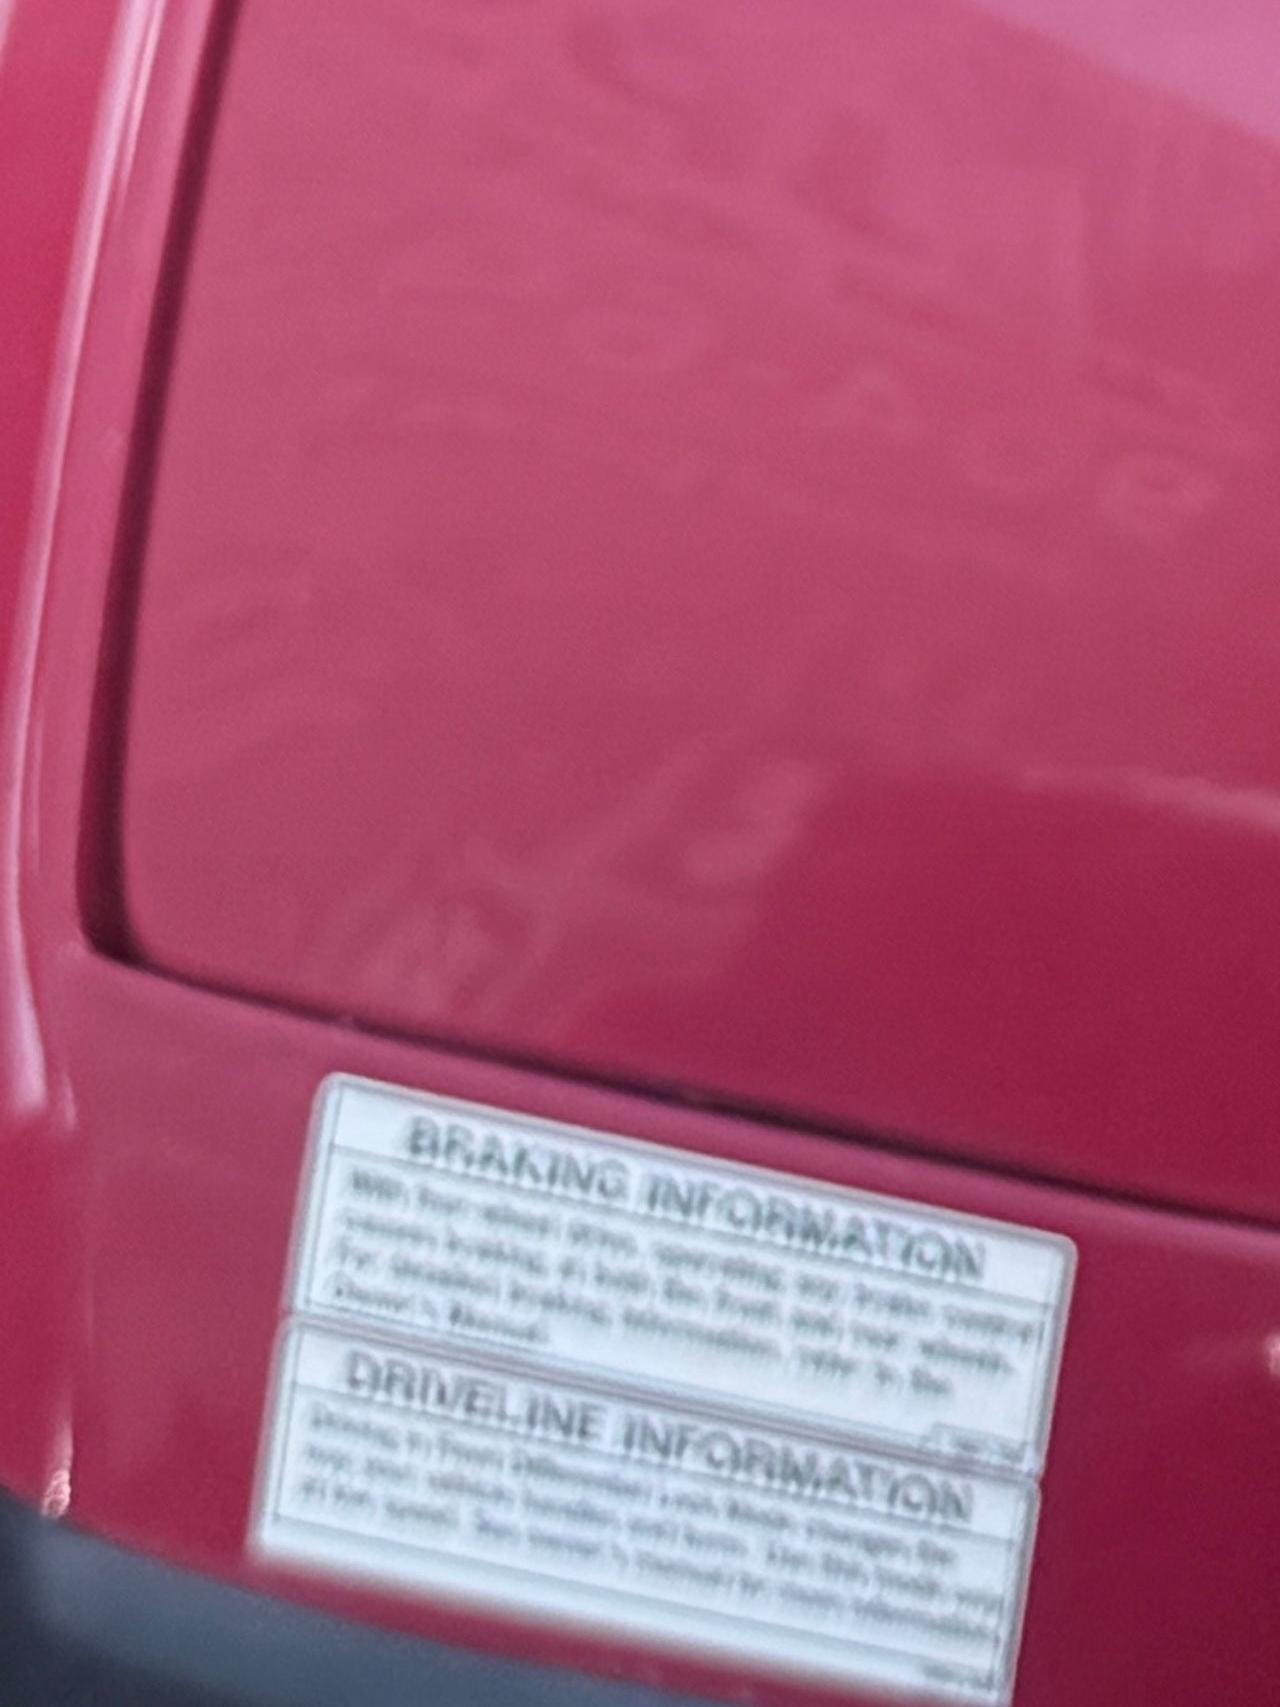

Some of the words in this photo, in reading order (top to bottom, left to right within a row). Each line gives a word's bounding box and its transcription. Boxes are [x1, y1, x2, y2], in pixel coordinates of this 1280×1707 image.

[406, 1115, 632, 1198] BRAKING
[644, 1172, 985, 1281] INFORMATION
[346, 1350, 604, 1438] DRIVELINE
[620, 1412, 974, 1522] INFORMATION
